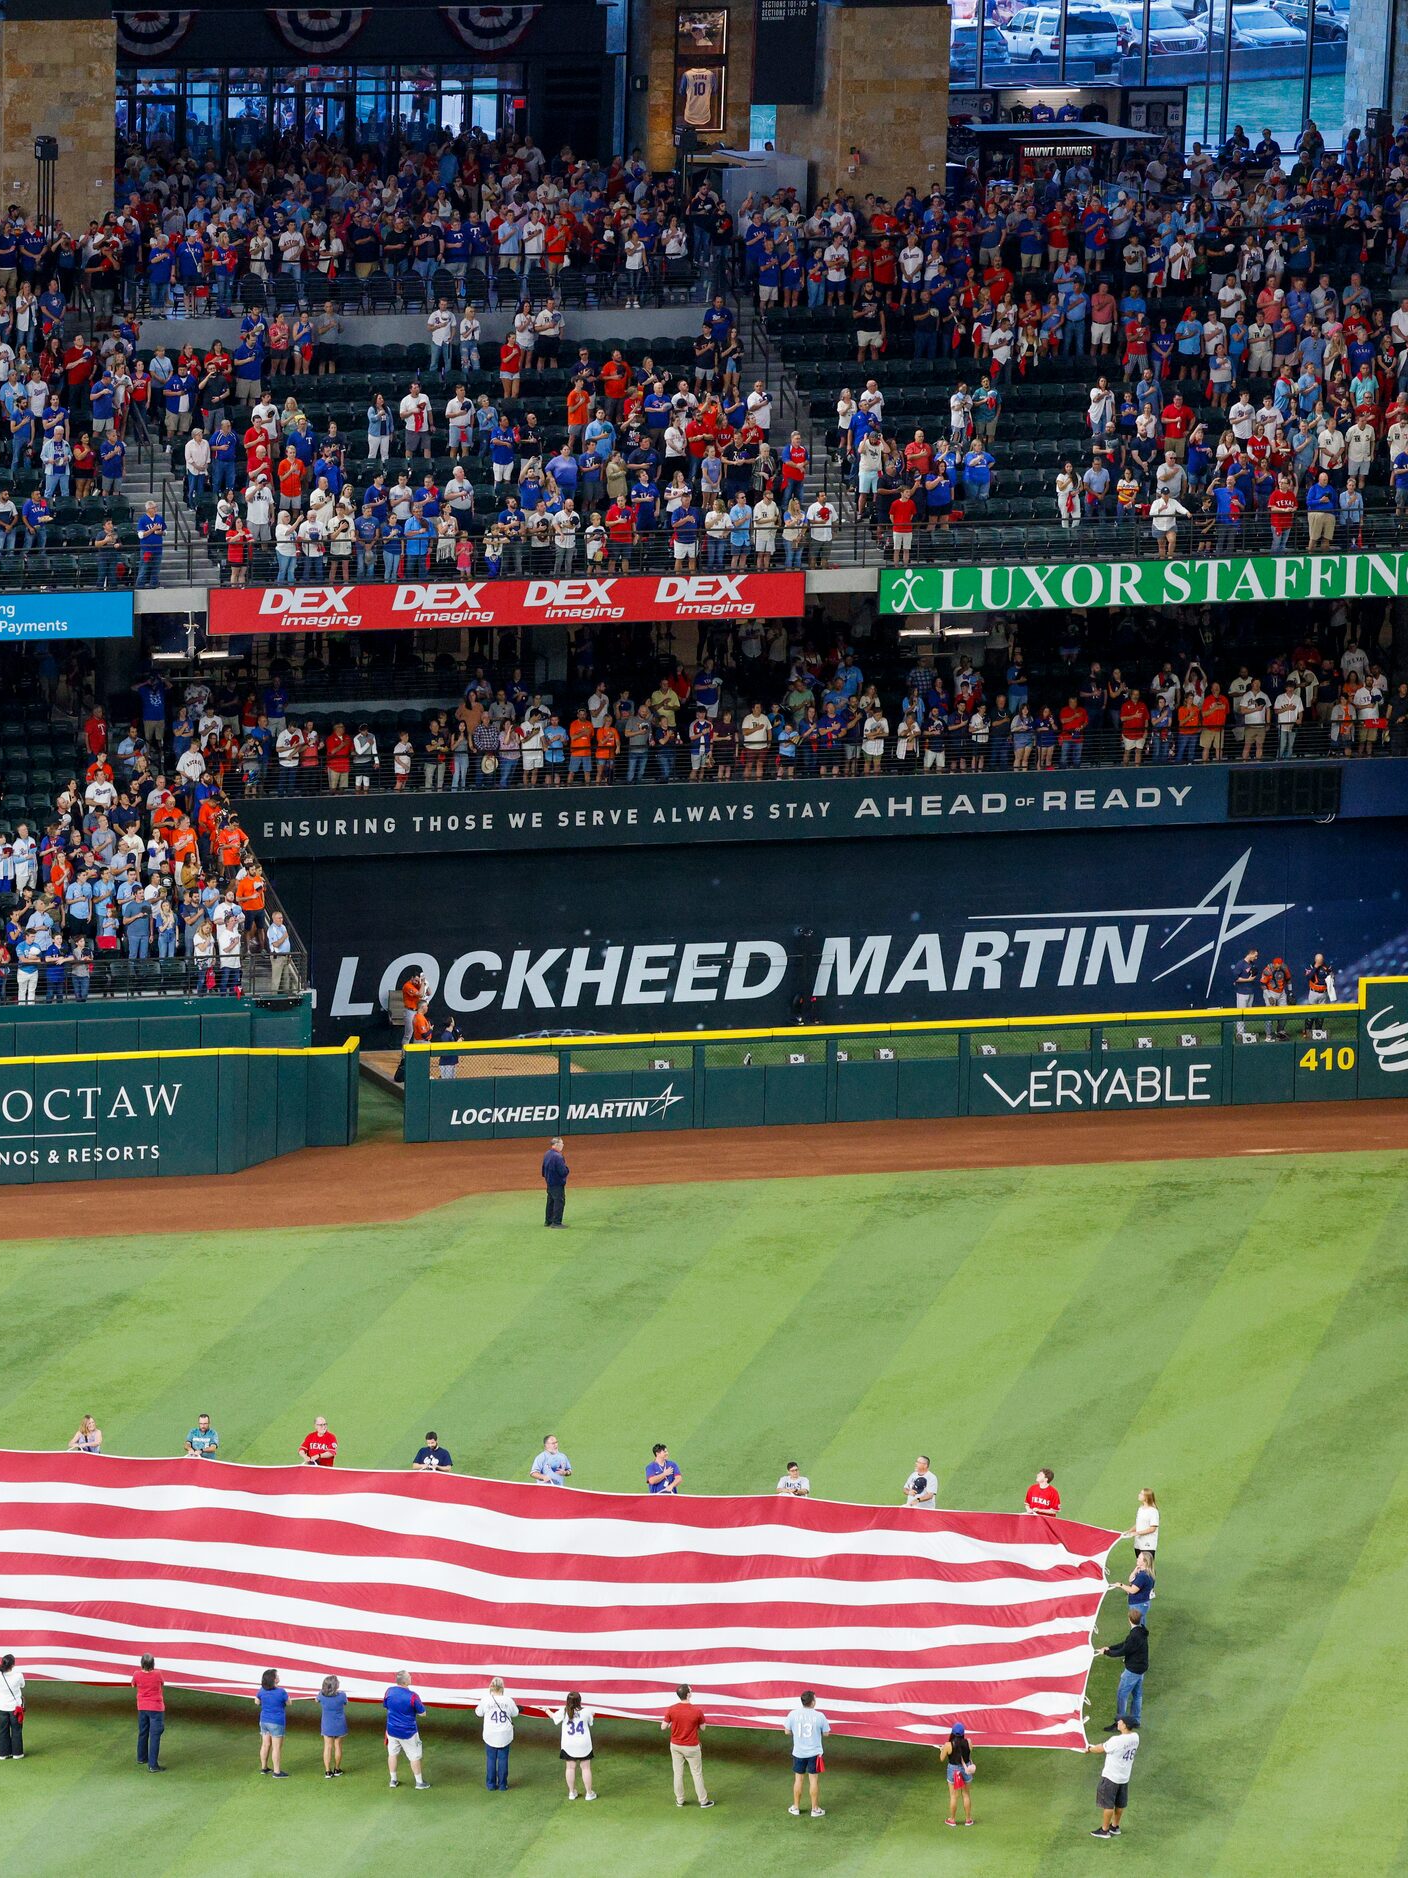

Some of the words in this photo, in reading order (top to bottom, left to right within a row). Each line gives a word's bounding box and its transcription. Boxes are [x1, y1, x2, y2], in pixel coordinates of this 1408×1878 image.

[694, 82, 705, 96] 10
[1024, 145, 1054, 155] HAWWT
[1056, 144, 1092, 154] DAWWGS
[654, 574, 748, 601] DEX
[940, 562, 1148, 612] LUXOR
[1162, 552, 1408, 606] STAFFIN
[259, 585, 356, 614] DEX
[392, 582, 487, 610] DEX
[522, 578, 616, 606] DEX
[414, 607, 494, 624] imaging
[544, 603, 624, 620] imaging
[675, 599, 755, 616] imaging
[280, 610, 362, 628] imaging
[97, 724, 105, 735] T
[264, 817, 396, 837] ENSURING
[412, 814, 494, 832] THOSE
[509, 812, 544, 829] WE
[558, 808, 638, 827] SERVE
[653, 804, 754, 823] ALWAYS
[769, 802, 832, 819] STAY
[854, 792, 1008, 818] AHEAD
[1015, 797, 1035, 807] OF
[1043, 786, 1192, 811] READY
[330, 941, 788, 1017] LOCKHEED
[812, 925, 1150, 996] MARTIN
[1299, 1046, 1356, 1071] 410
[983, 1060, 1211, 1107] VÉRYABLE
[450, 1105, 560, 1125] LOCKHEED
[566, 1101, 649, 1121] MARTIN
[48, 1149, 59, 1162] &
[68, 1145, 160, 1162] RESORTS
[1032, 1496, 1050, 1505] TEXAS
[491, 1711, 507, 1723] 48
[567, 1721, 584, 1735] 34
[798, 1722, 812, 1738] 13
